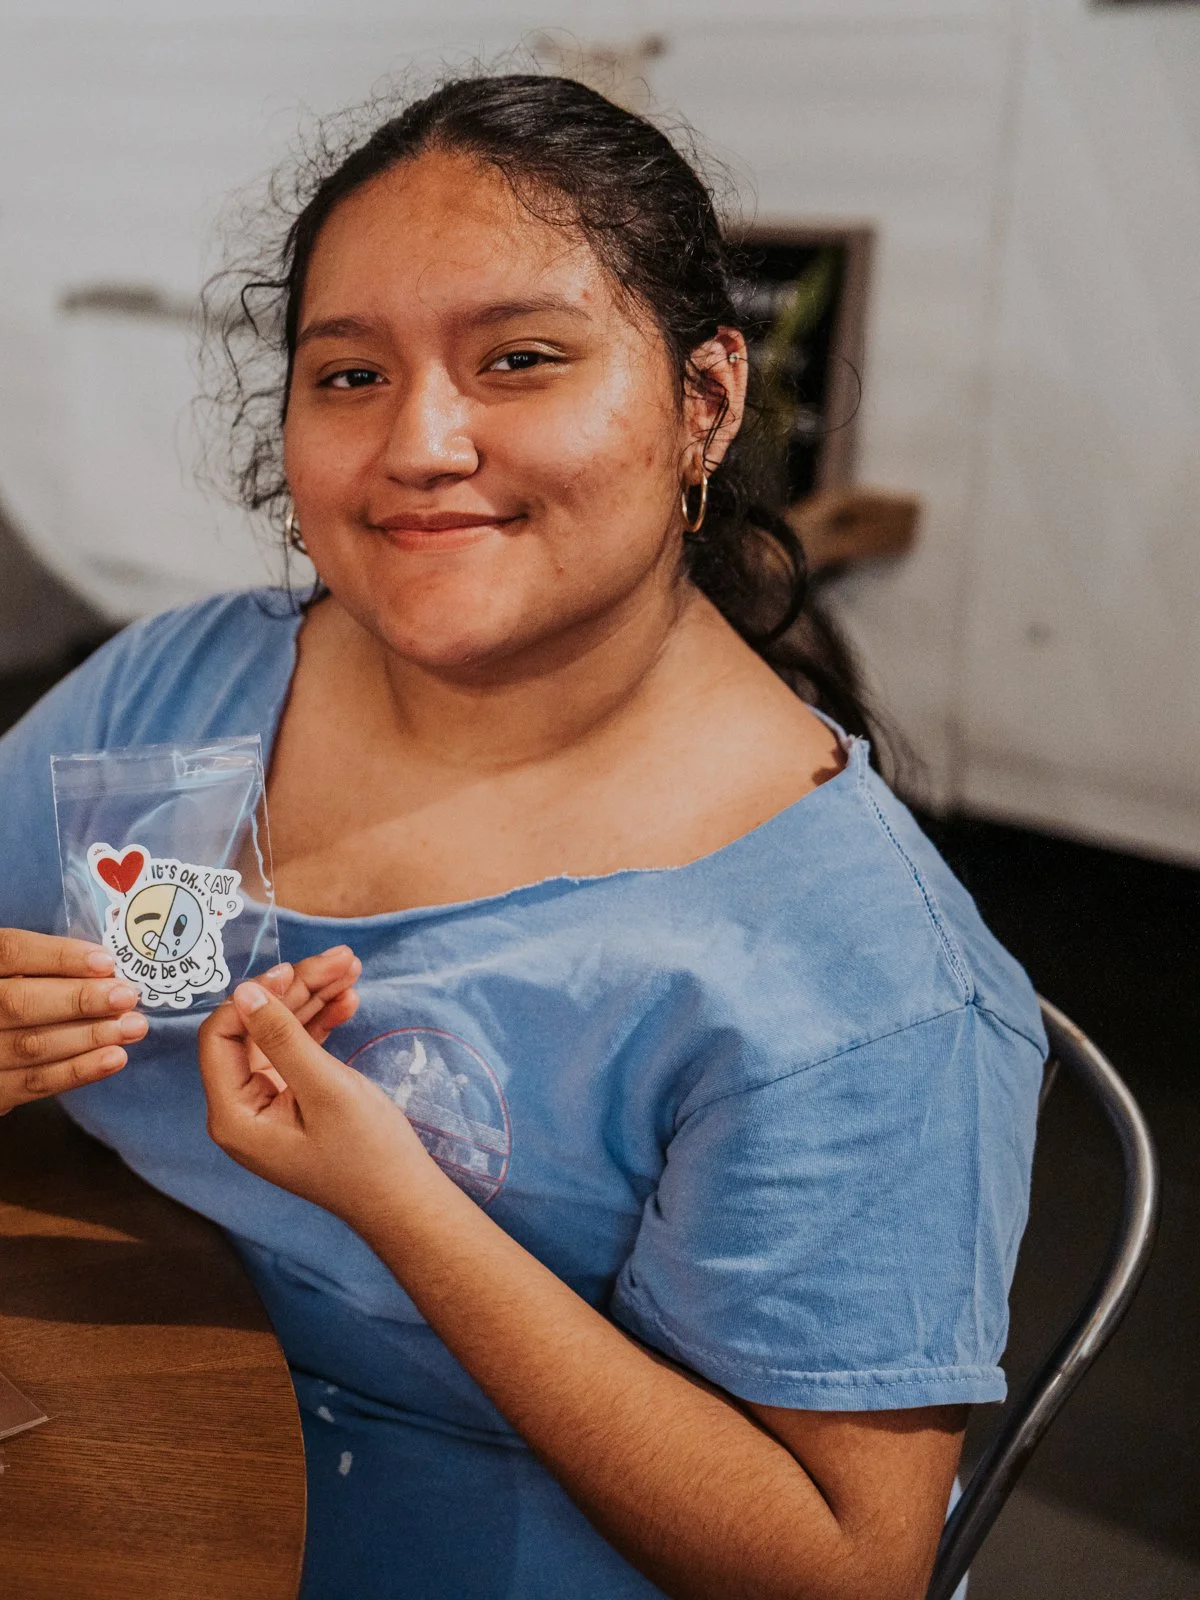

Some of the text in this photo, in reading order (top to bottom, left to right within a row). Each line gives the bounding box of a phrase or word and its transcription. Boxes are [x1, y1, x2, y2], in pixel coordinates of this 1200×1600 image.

[131, 958, 158, 980] not
[161, 963, 177, 980] be
[179, 956, 201, 974] OK
